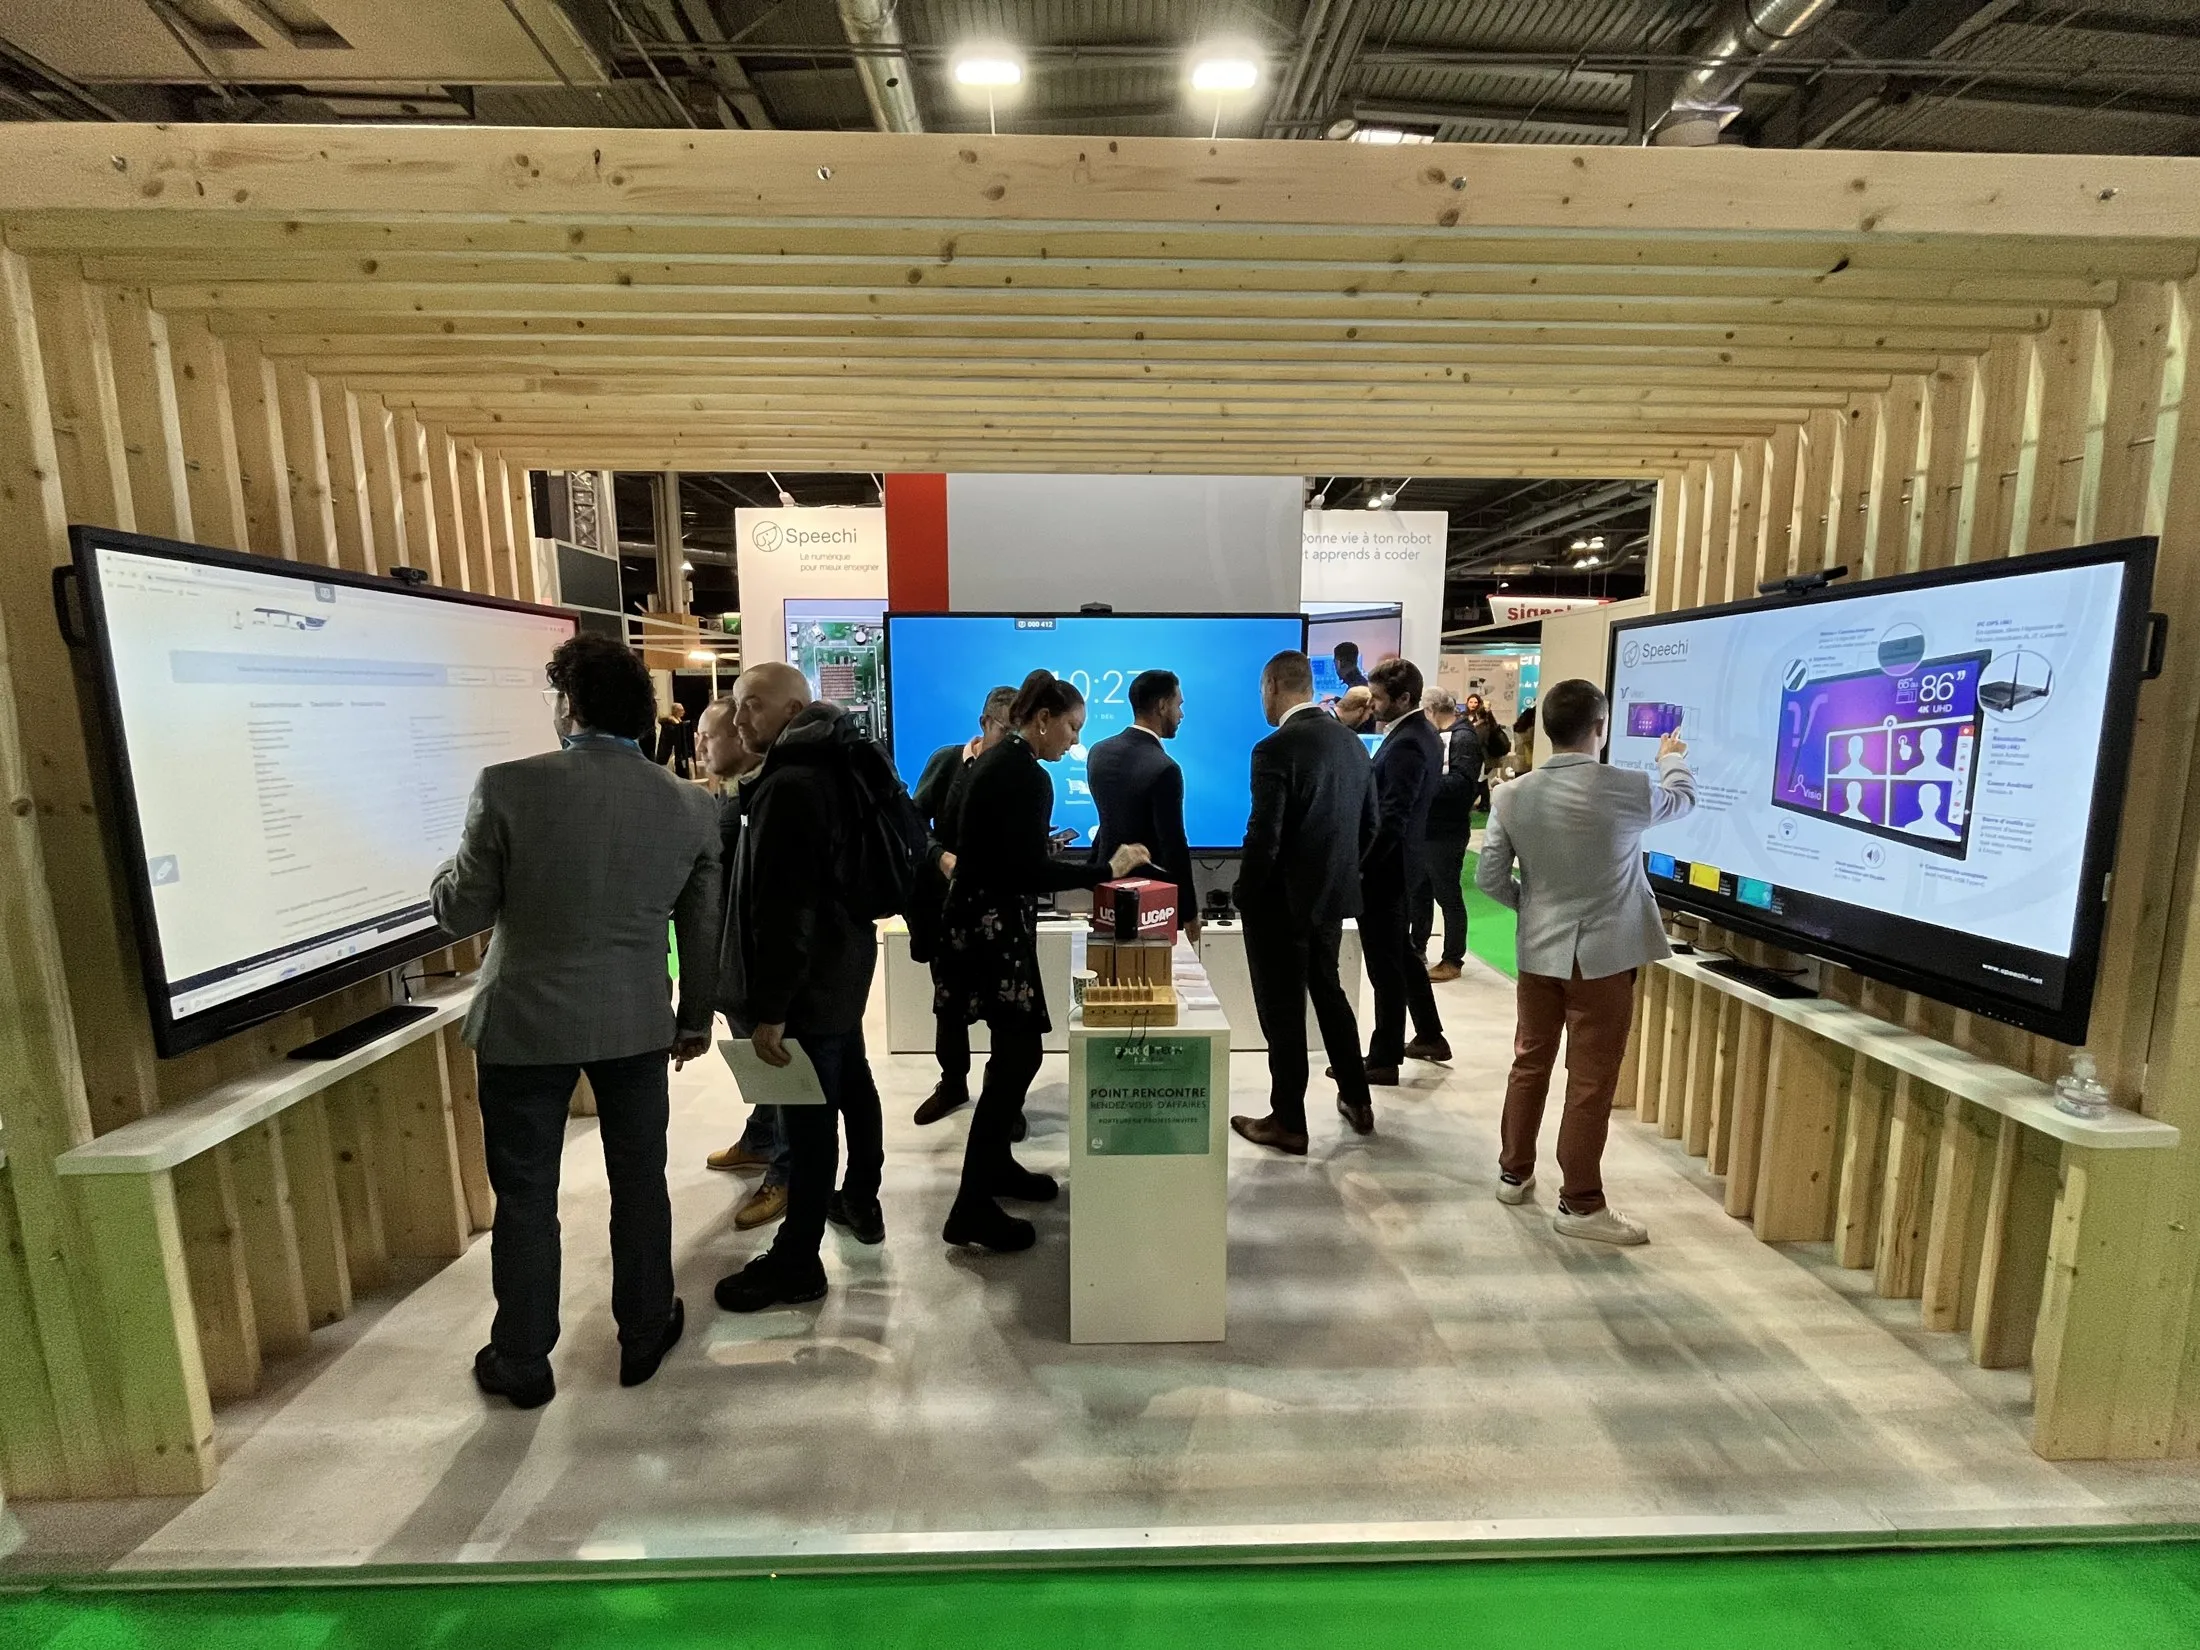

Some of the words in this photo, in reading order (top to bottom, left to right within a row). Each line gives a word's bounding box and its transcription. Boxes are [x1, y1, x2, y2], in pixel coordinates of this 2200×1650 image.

[786, 528, 857, 546] Speechi
[1341, 532, 1359, 545] vie
[1362, 532, 1370, 545] à
[1373, 534, 1394, 545] ton
[1397, 532, 1432, 545] robot
[811, 552, 851, 563] numérique
[1312, 548, 1375, 563] apprends
[1374, 547, 1381, 560] à
[1384, 547, 1420, 560] coder
[800, 564, 818, 573] pour
[819, 563, 842, 571] mieux
[843, 563, 880, 573] enseigner
[1642, 639, 1689, 660] Speechi
[1918, 705, 1930, 714] 4K
[1932, 704, 1953, 713] UHD
[1099, 906, 1116, 922] UG
[1141, 907, 1175, 926] UGAP
[1090, 1088, 1129, 1099] POINT
[1132, 1087, 1206, 1098] RENCONTRE
[1090, 1101, 1153, 1110] RENDEZ-VOUS
[1157, 1100, 1207, 1109] D'AFFAIRES
